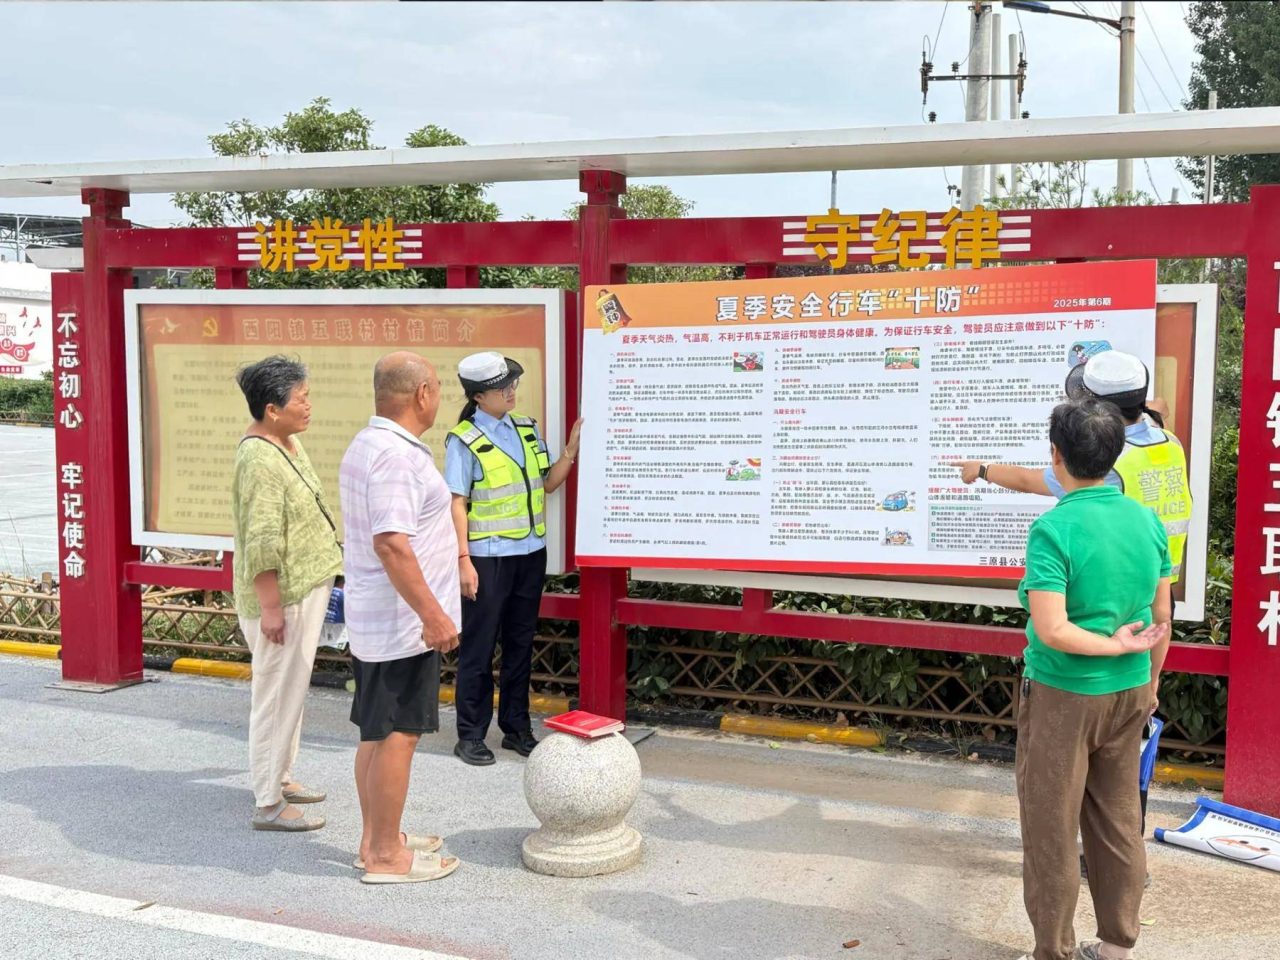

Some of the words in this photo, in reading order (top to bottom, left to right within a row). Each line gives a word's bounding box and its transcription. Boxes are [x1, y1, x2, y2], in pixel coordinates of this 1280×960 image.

[254, 217, 405, 272] 讲党性
[803, 204, 1003, 270] 守纪律
[1053, 296, 1112, 309] 2025年第6期
[241, 318, 477, 343] 西阳镇五联村村情简介
[1137, 466, 1185, 504] 警察
